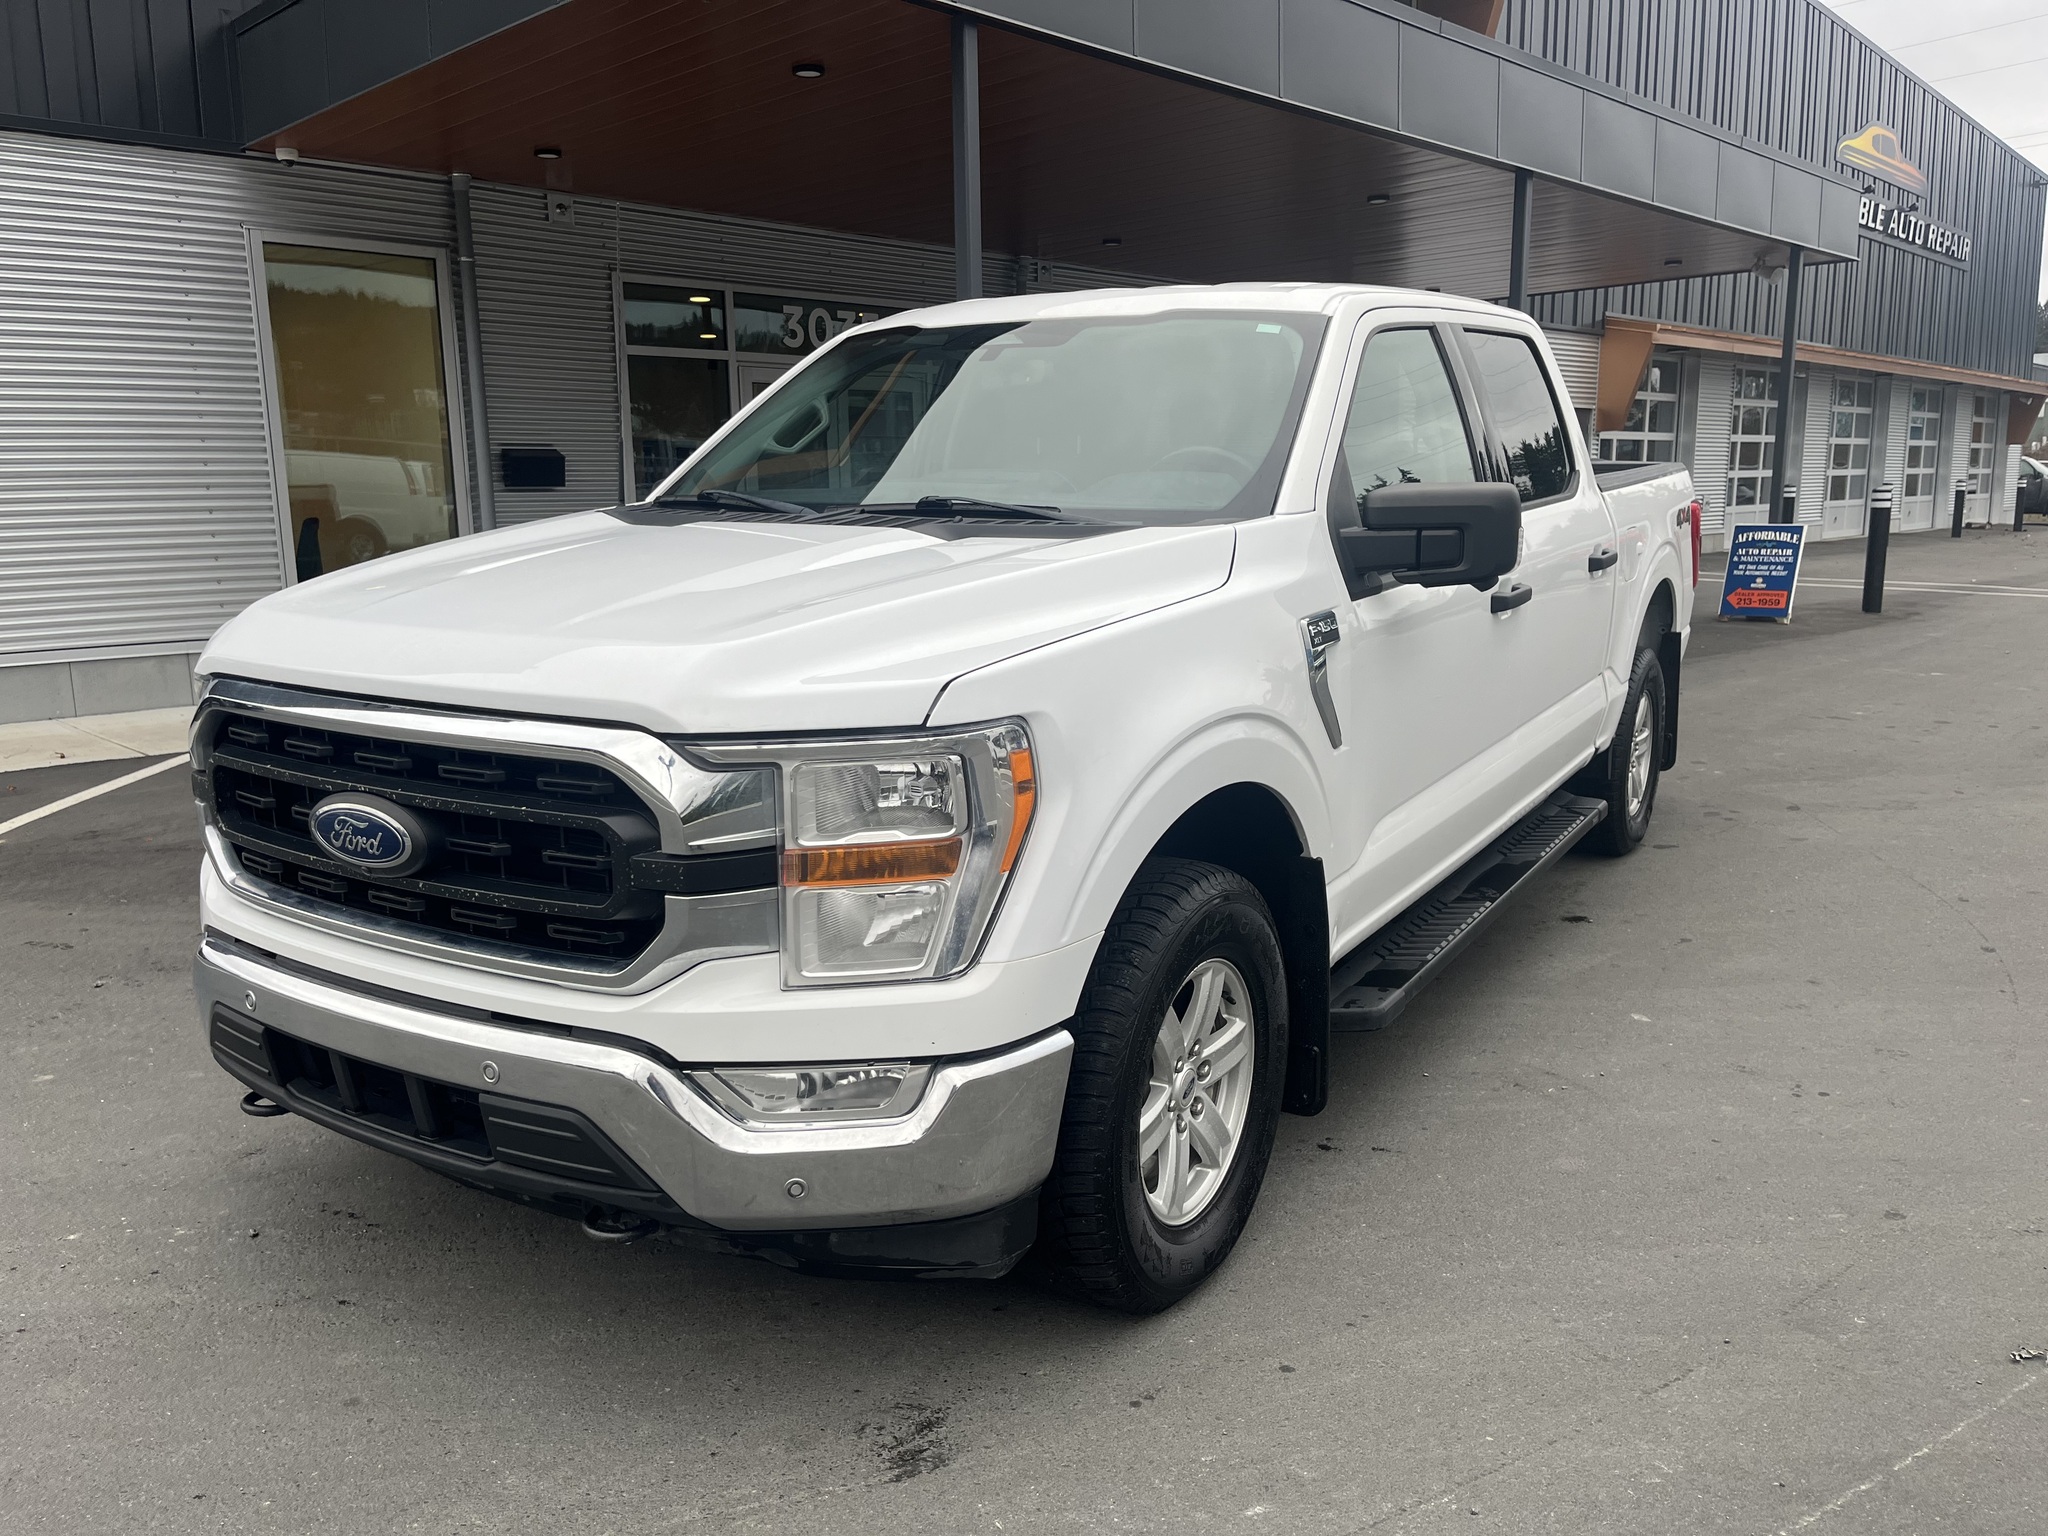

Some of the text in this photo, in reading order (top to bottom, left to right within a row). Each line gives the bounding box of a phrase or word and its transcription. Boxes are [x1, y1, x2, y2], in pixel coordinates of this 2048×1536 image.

[1888, 209, 1925, 245] AUTO
[1927, 223, 1971, 261] REPAIR
[782, 304, 879, 349] 303
[1735, 531, 1800, 544] AFFORDABLE
[1760, 548, 1793, 556] REPAIR
[1736, 597, 1781, 607] 213-1959
[1309, 619, 1338, 636] F-150
[330, 816, 383, 856] Ford
